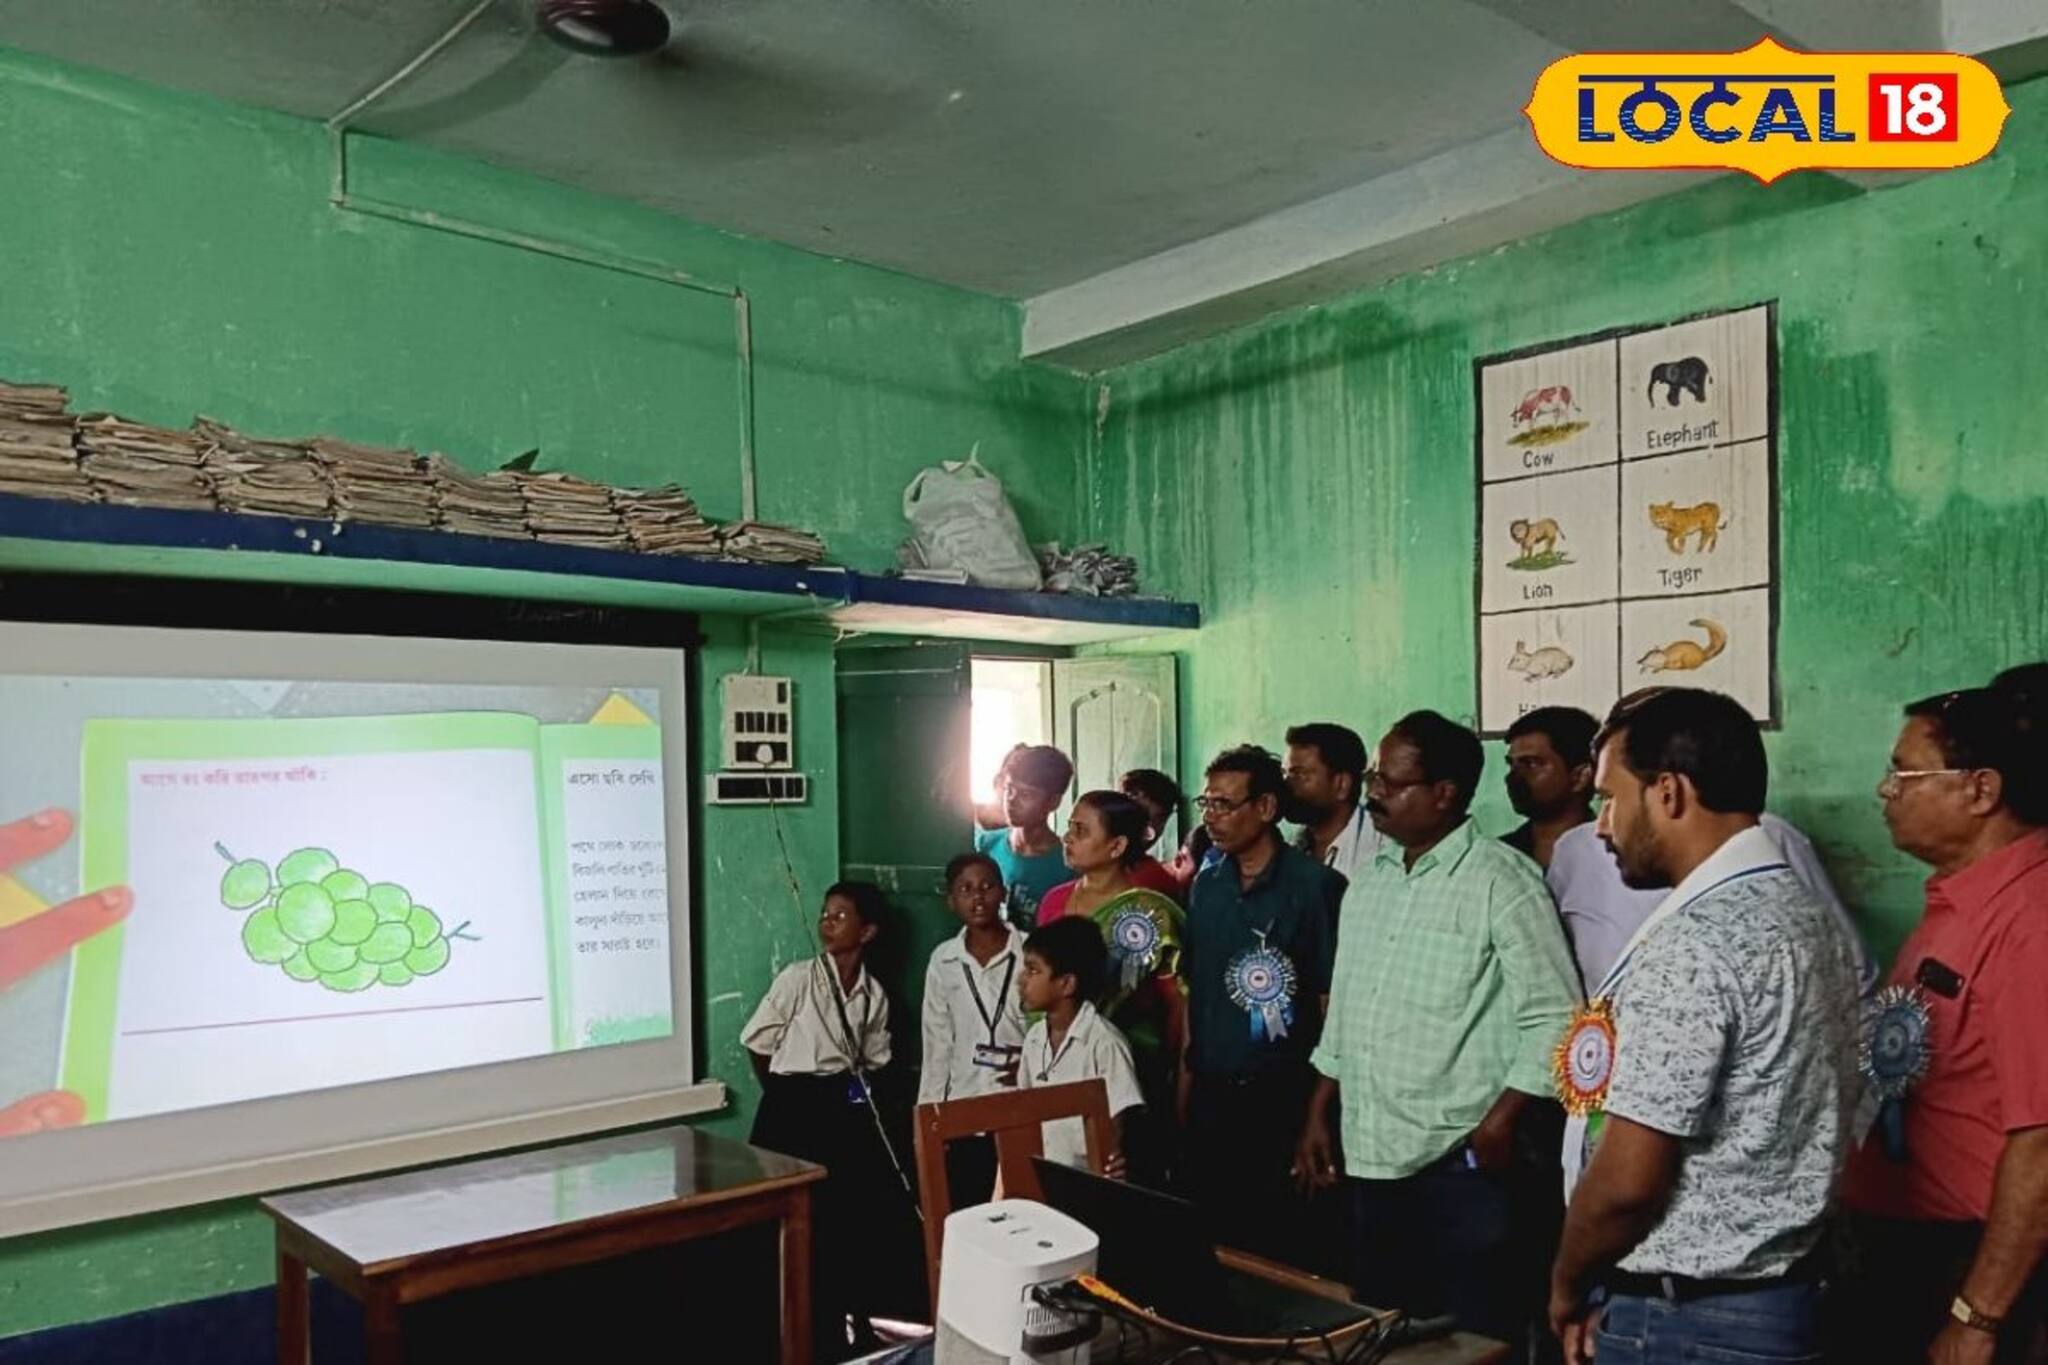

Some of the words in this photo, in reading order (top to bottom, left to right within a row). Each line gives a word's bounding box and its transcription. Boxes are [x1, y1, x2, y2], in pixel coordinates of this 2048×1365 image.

[1522, 450, 1554, 470] Cow
[1657, 567, 1703, 589] Tiger
[1522, 582, 1553, 600] Lion
